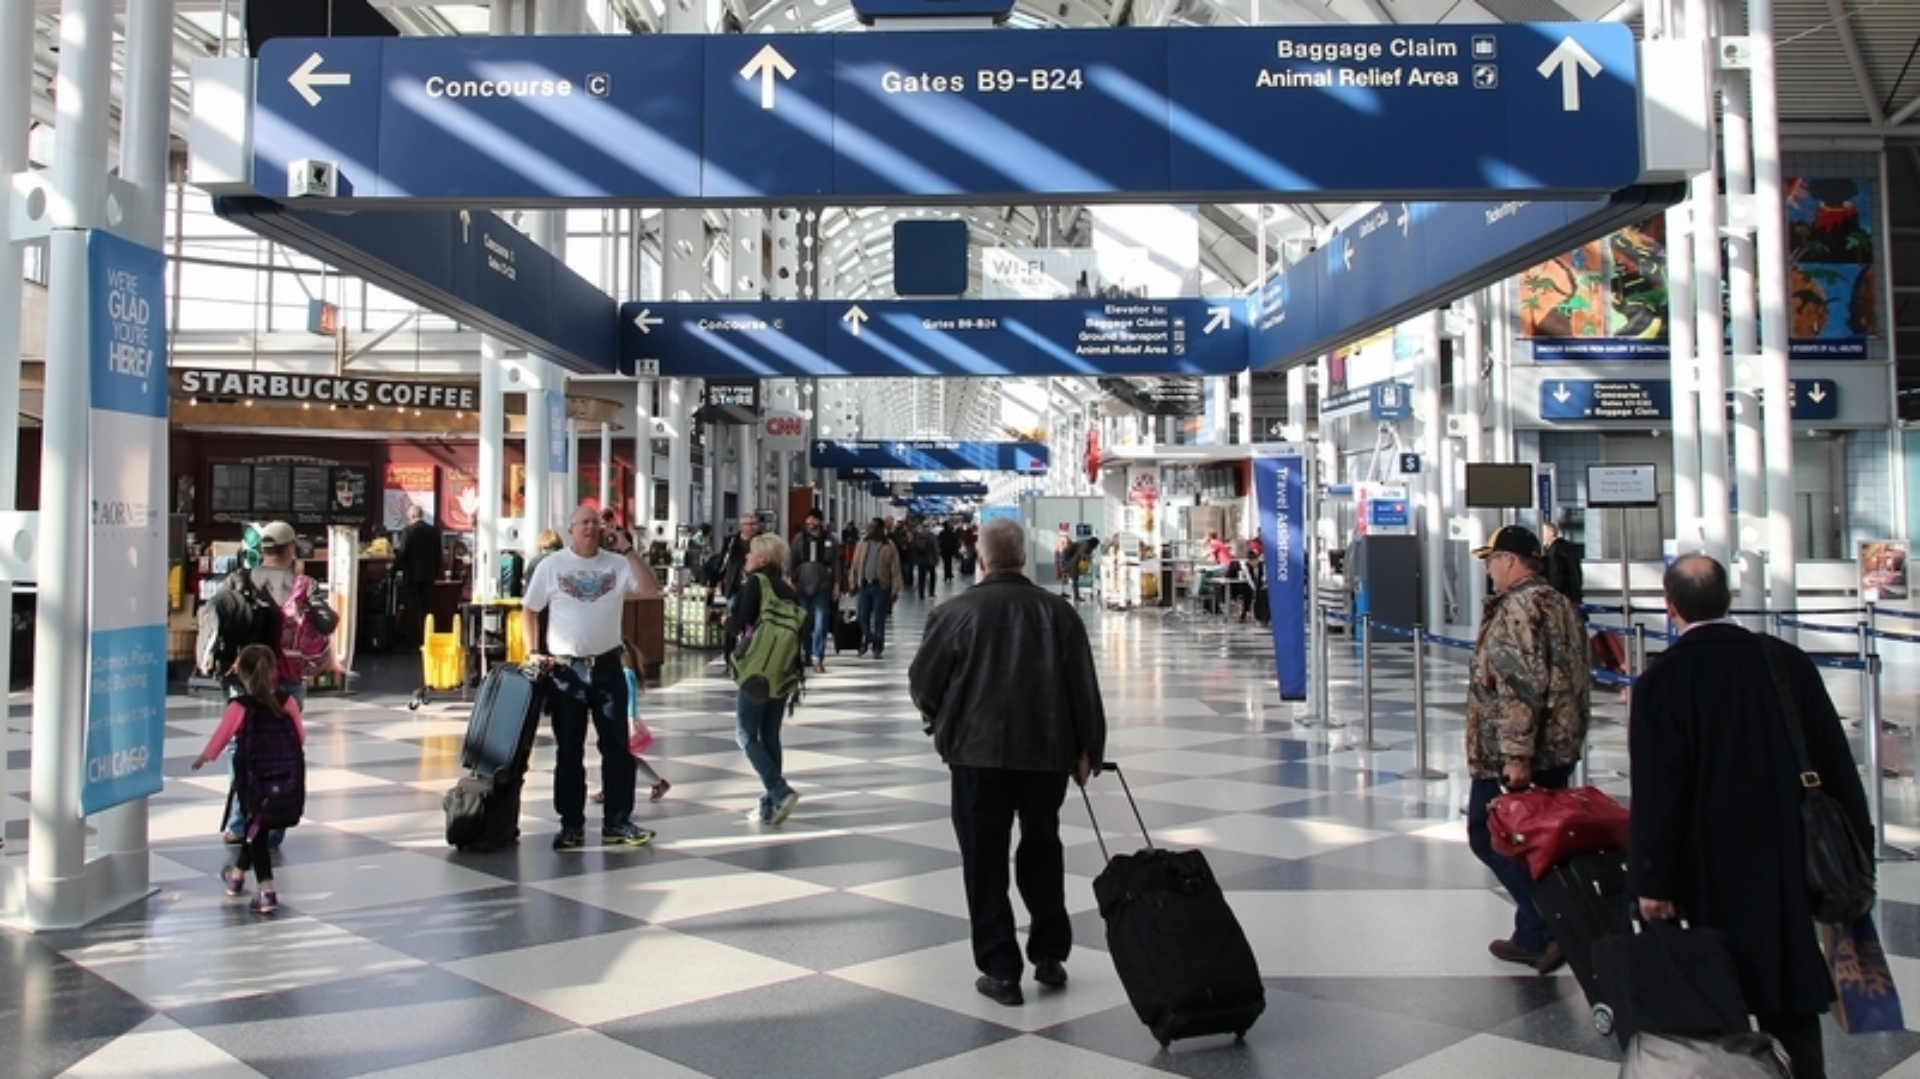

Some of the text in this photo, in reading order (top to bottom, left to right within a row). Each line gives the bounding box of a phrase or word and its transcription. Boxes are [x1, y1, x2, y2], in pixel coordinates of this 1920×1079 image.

[1277, 37, 1458, 61] Baggage Claim
[881, 69, 1084, 93] Gates B9-B24
[1256, 67, 1459, 88] Animal Relief Area
[425, 76, 606, 97] Concourse C
[992, 260, 1046, 275] WI-FI
[108, 288, 150, 325] GLAD
[1104, 304, 1168, 315] Elevator to:
[699, 318, 767, 331] Concourse
[922, 318, 955, 330] Gates
[1085, 317, 1168, 330] Baggage Claim
[1078, 331, 1168, 343] Ground Transport
[1075, 345, 1168, 355] Animal Relief Area
[109, 341, 154, 394] HERE!
[182, 370, 474, 408] STARBUCKS COFFEE
[1593, 391, 1641, 399] Concourse
[710, 394, 753, 406] STORE
[1594, 408, 1659, 417] Baggage Claim
[766, 417, 802, 436] CNN
[1277, 467, 1289, 582] Travel Assistance
[89, 745, 150, 782] CHICAGO
